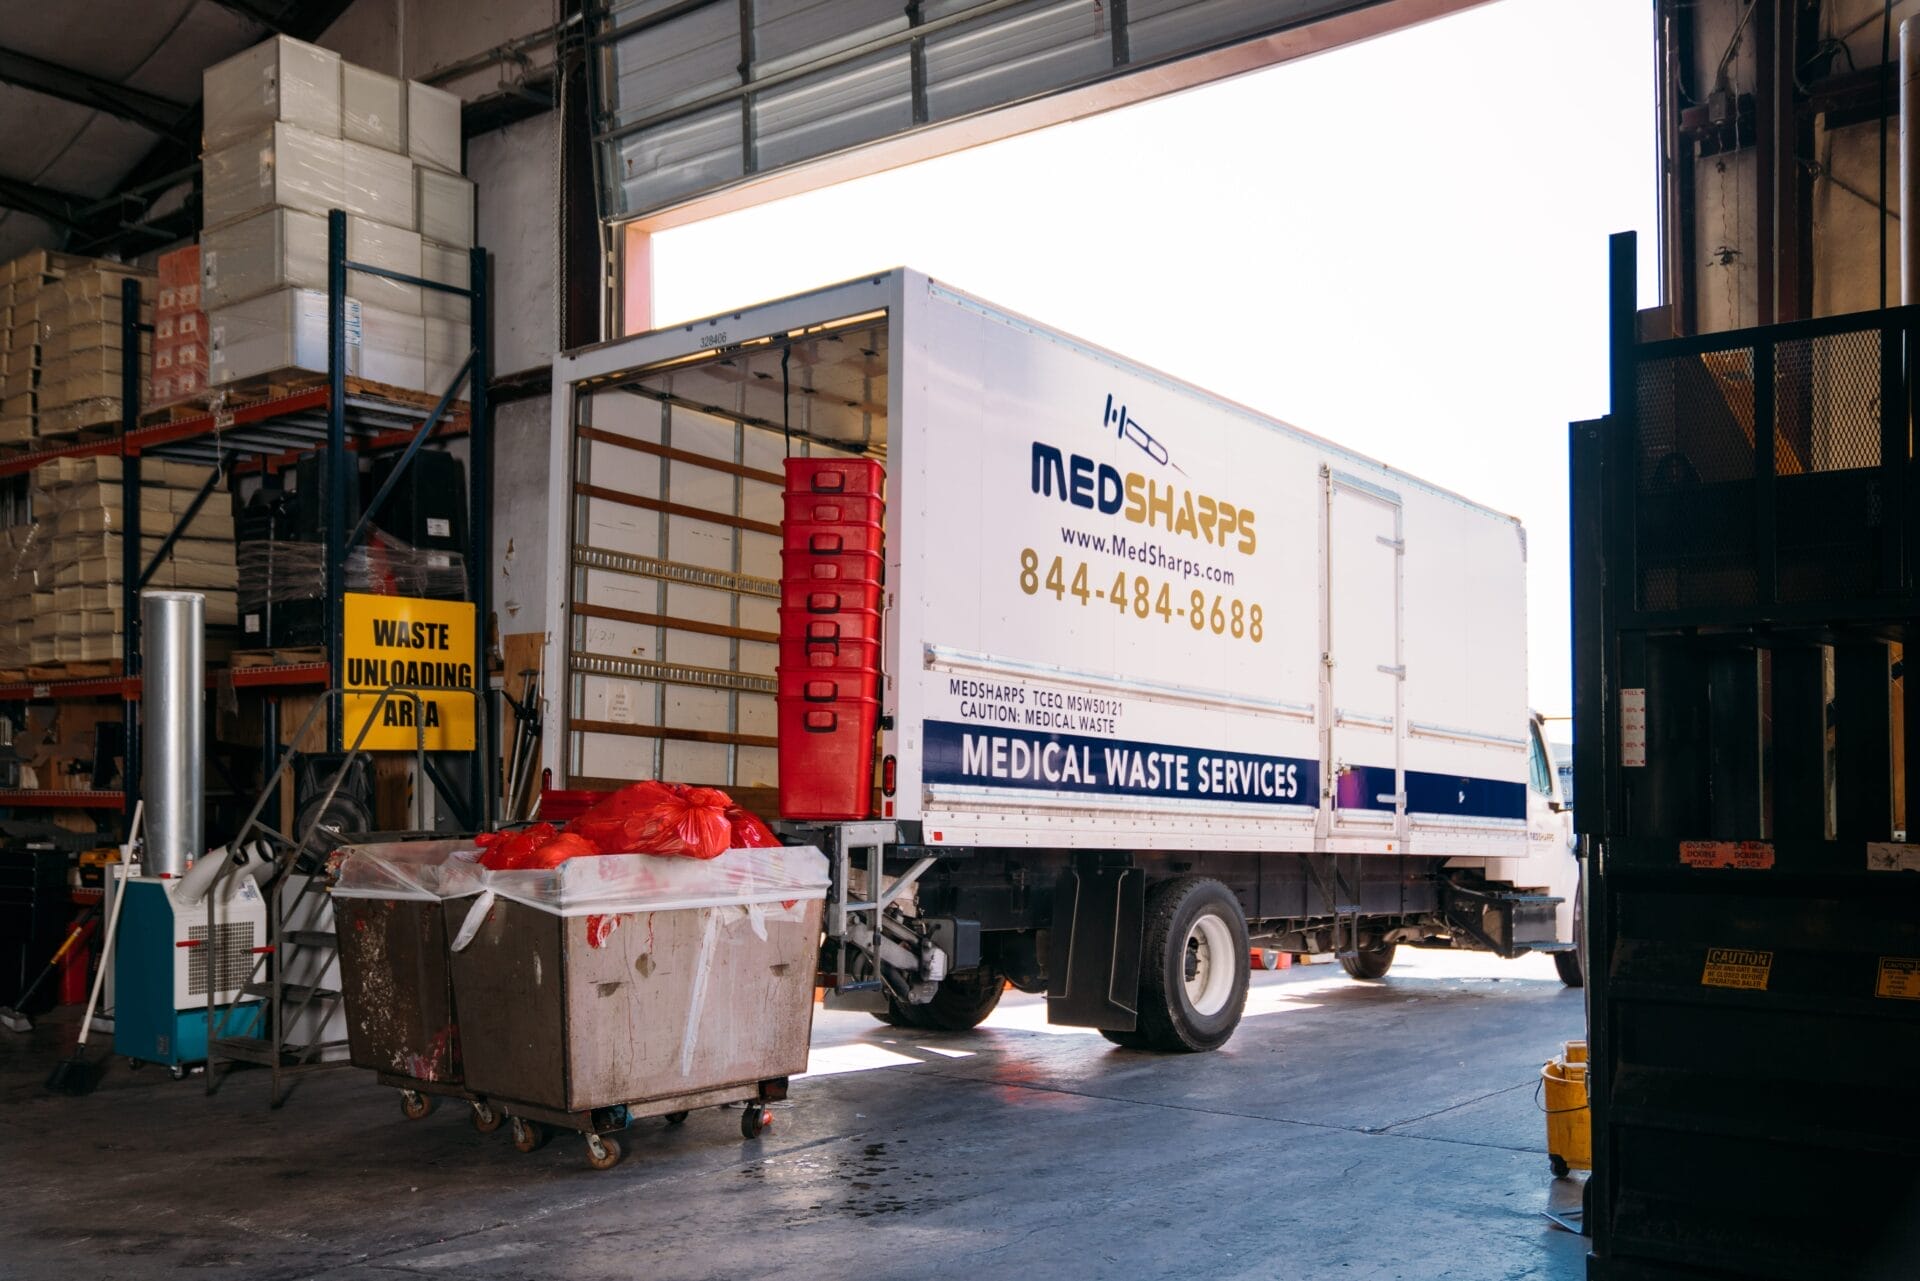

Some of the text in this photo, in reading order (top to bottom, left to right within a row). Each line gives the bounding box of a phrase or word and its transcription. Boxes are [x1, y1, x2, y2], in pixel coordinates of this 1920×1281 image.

[1032, 441, 1256, 555] MEDSHARPS
[1061, 527, 1235, 585] www.MedSharps.com
[1020, 548, 1263, 643] 844-484-8688
[373, 619, 449, 650] WASTE
[347, 658, 472, 688] UNLOADING
[950, 679, 1123, 716] MEDSHARPS TCEQ MSW50121
[960, 701, 1115, 734] CAUTION: MEDICAL WASTE
[962, 734, 1298, 798] MEDICAL WASTE SERVICES
[1712, 951, 1768, 965] CAUTION
